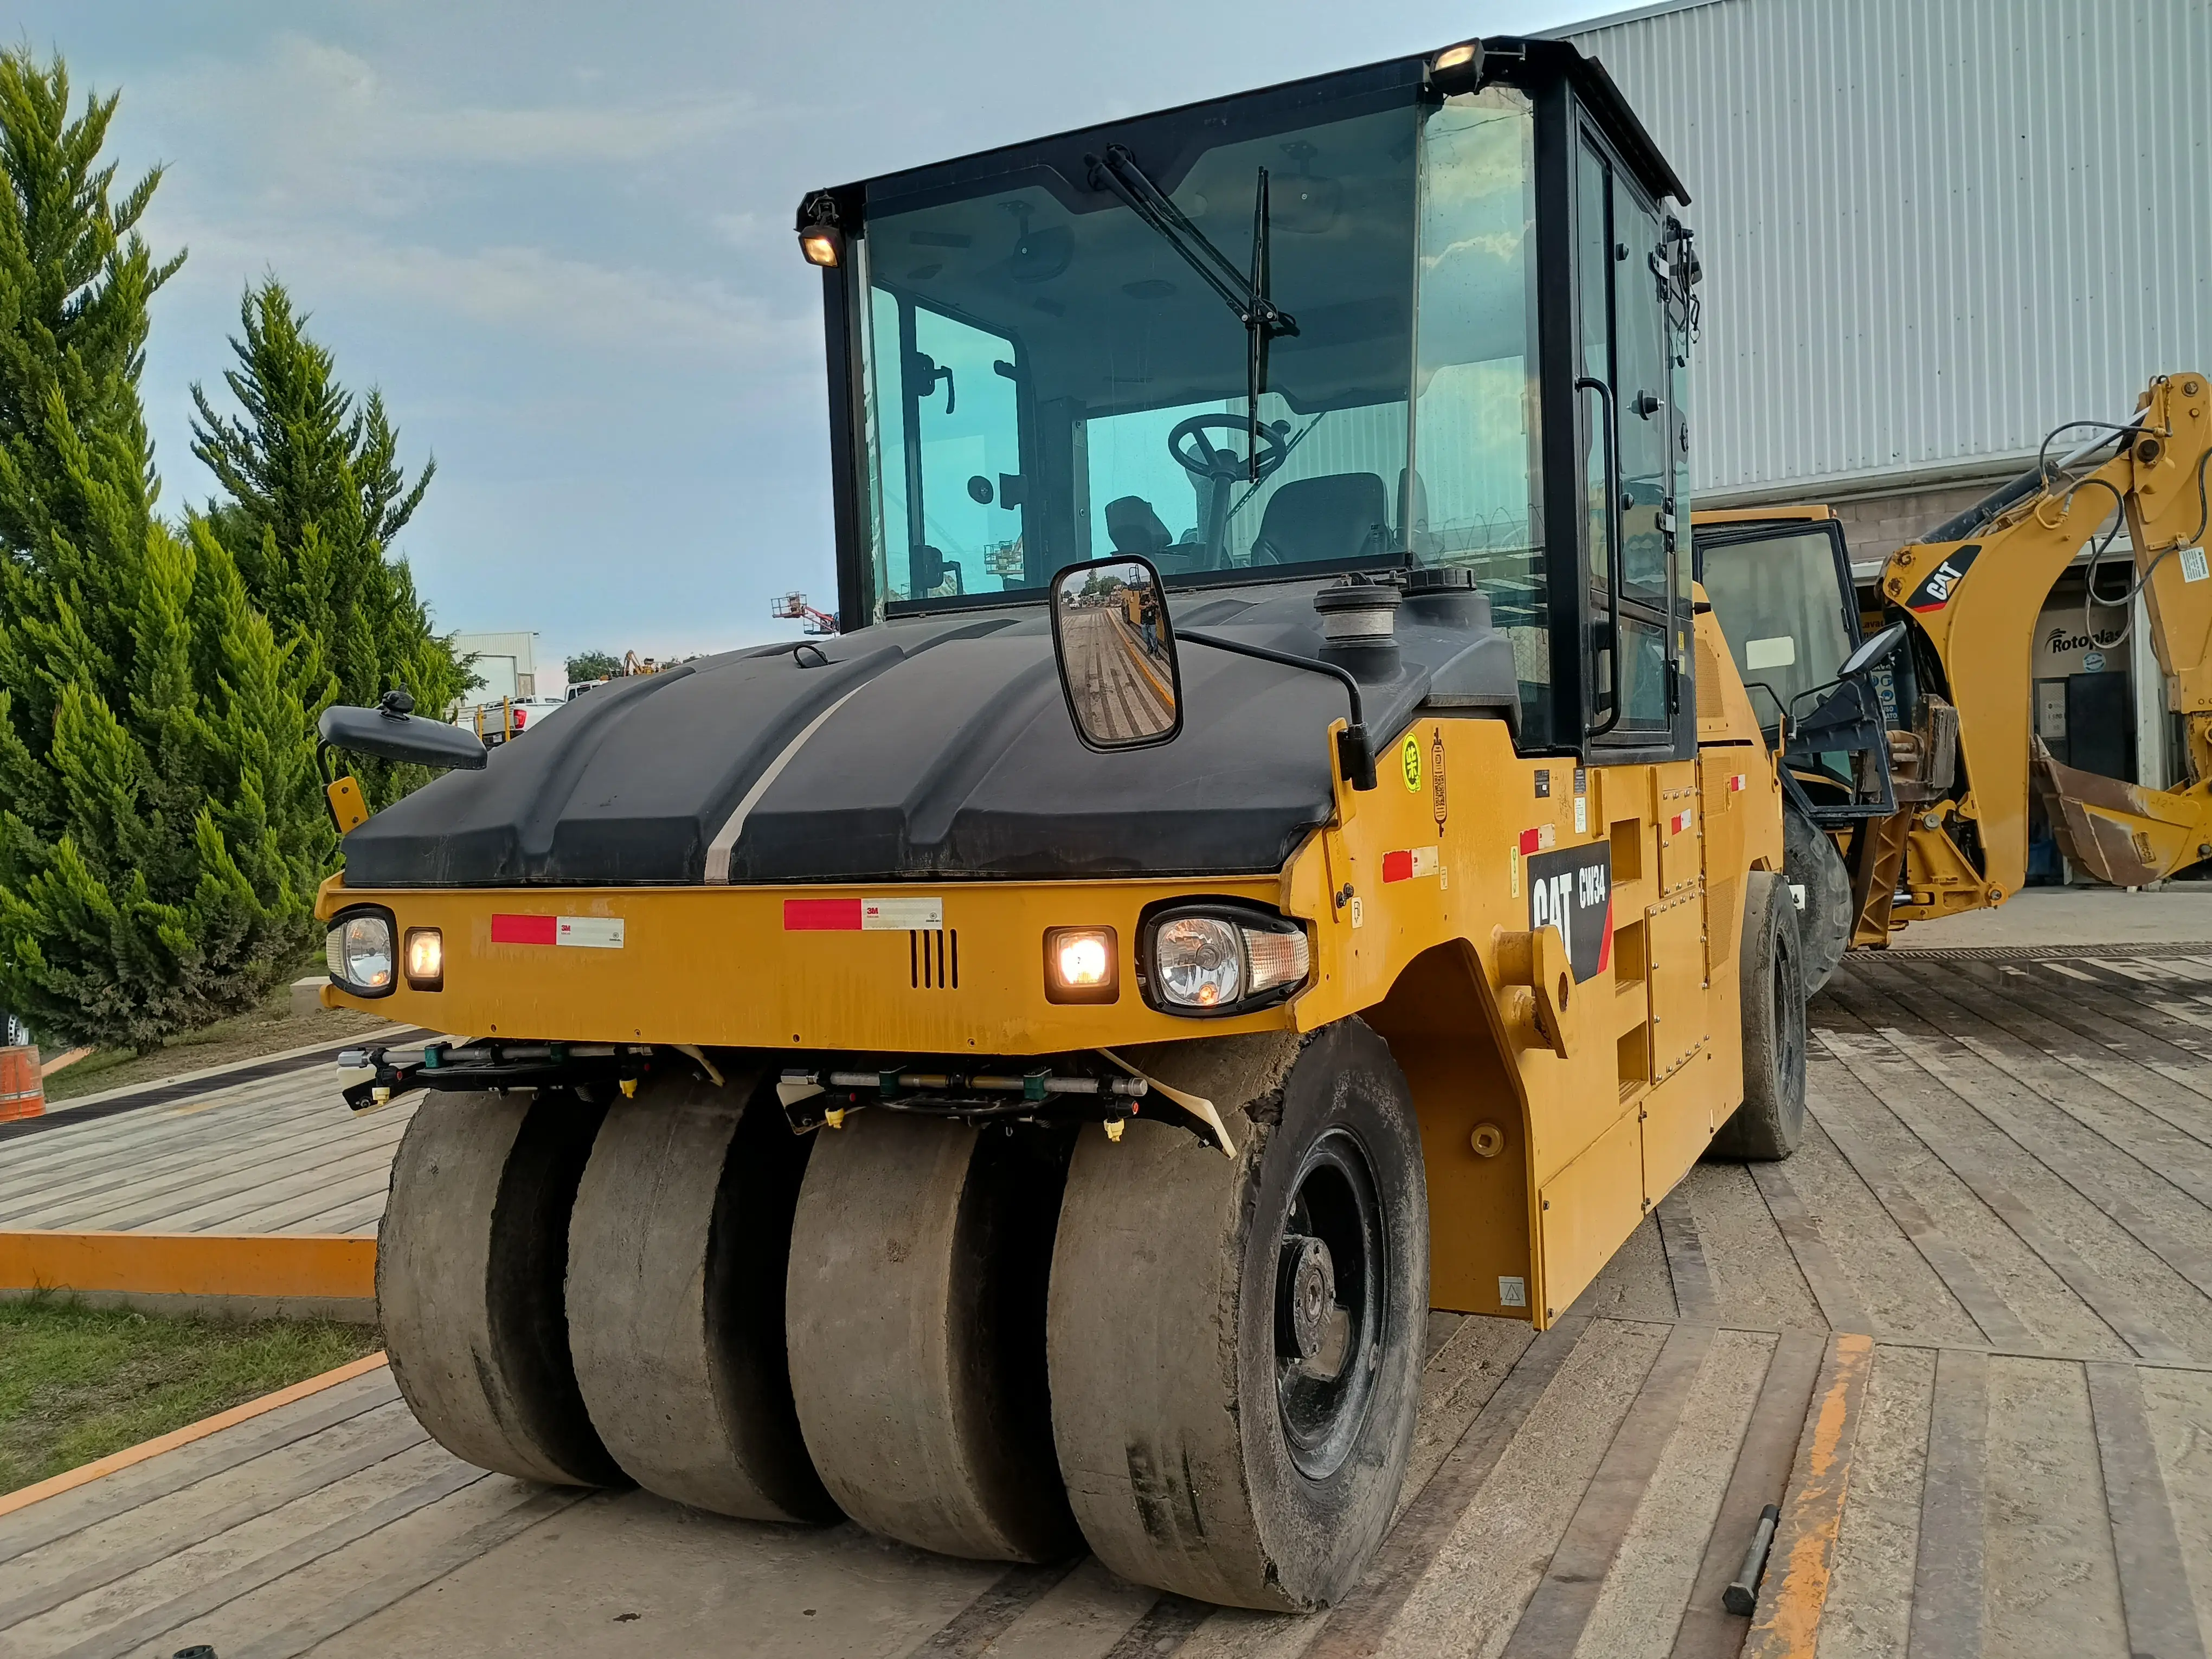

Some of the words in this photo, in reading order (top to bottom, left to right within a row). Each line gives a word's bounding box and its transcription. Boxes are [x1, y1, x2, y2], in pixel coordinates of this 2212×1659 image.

[1926, 561, 1963, 600] CAT
[1406, 745, 1417, 779] 柴
[1533, 872, 1572, 964] CAT
[1579, 864, 1605, 909] CW34
